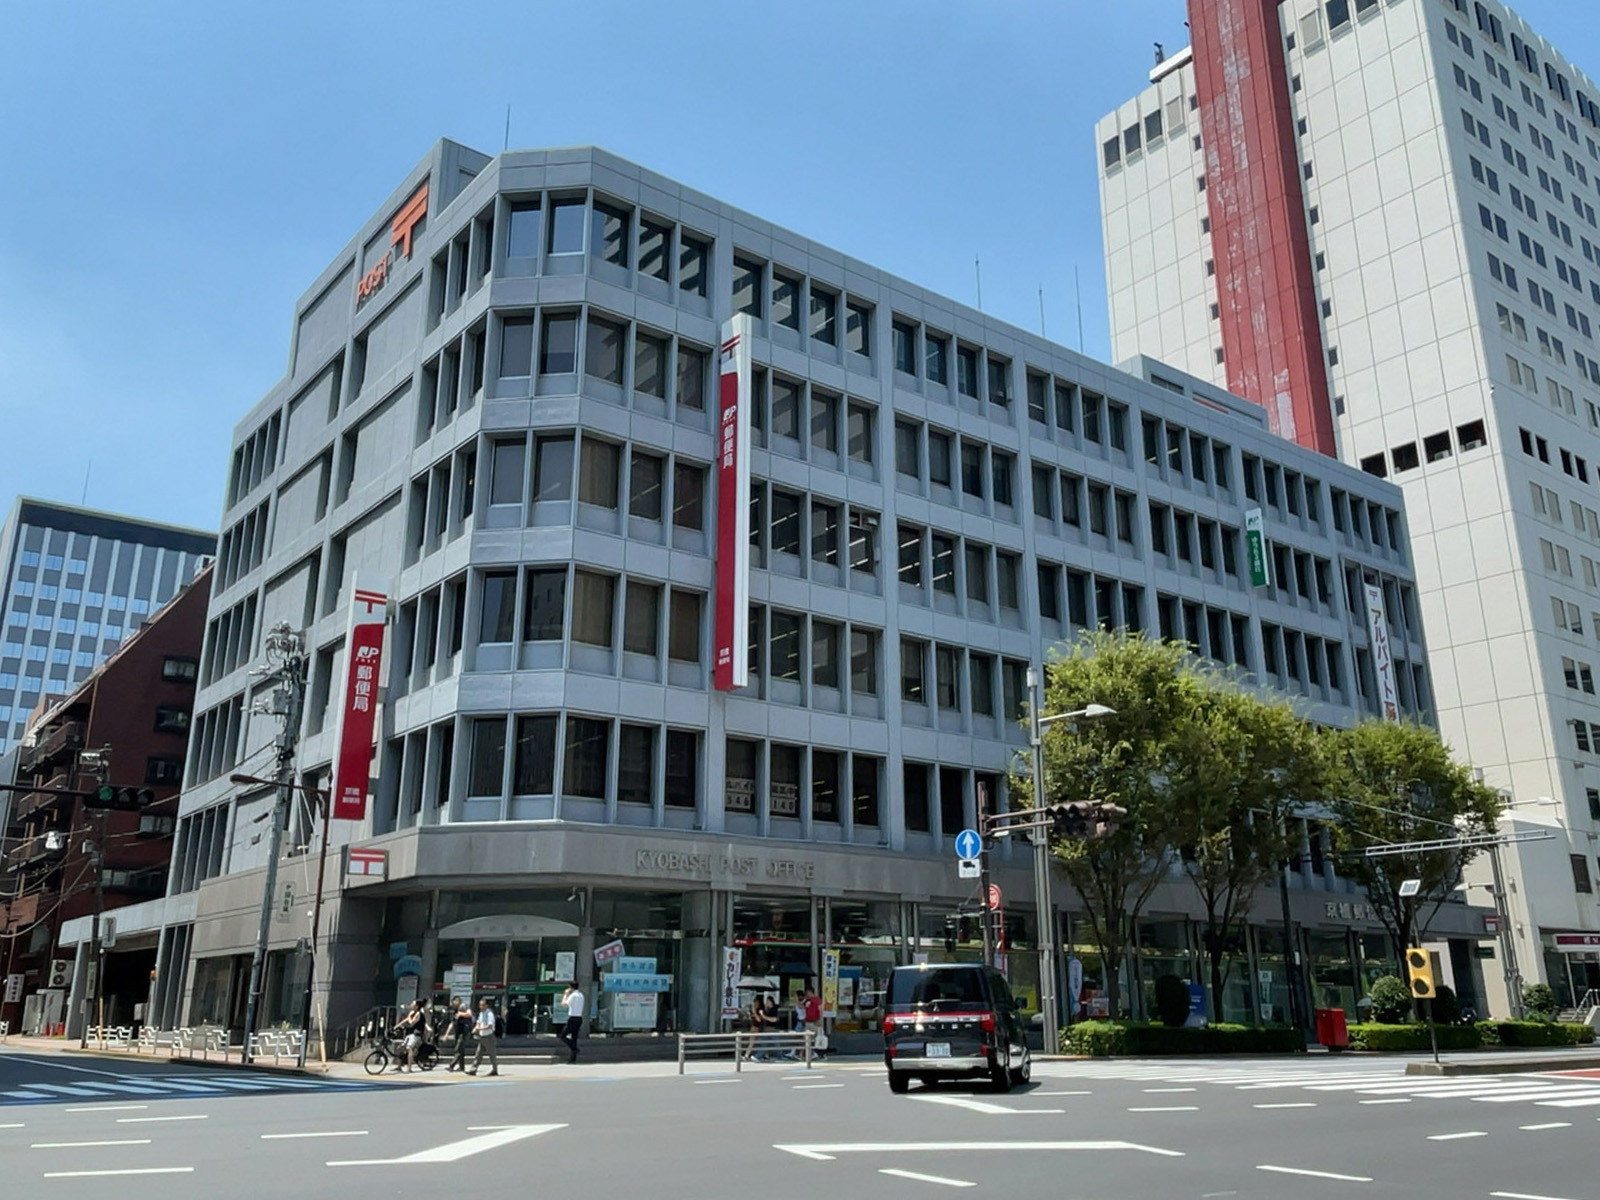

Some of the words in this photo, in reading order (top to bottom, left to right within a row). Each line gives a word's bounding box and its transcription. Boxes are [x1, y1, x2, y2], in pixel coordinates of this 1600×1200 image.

[356, 250, 392, 304] POST
[722, 423, 734, 469] 郵便局
[353, 665, 373, 712] 郵便局
[636, 850, 712, 874] KYOBASHI
[720, 856, 758, 876] POST
[766, 859, 815, 880] OFFICE
